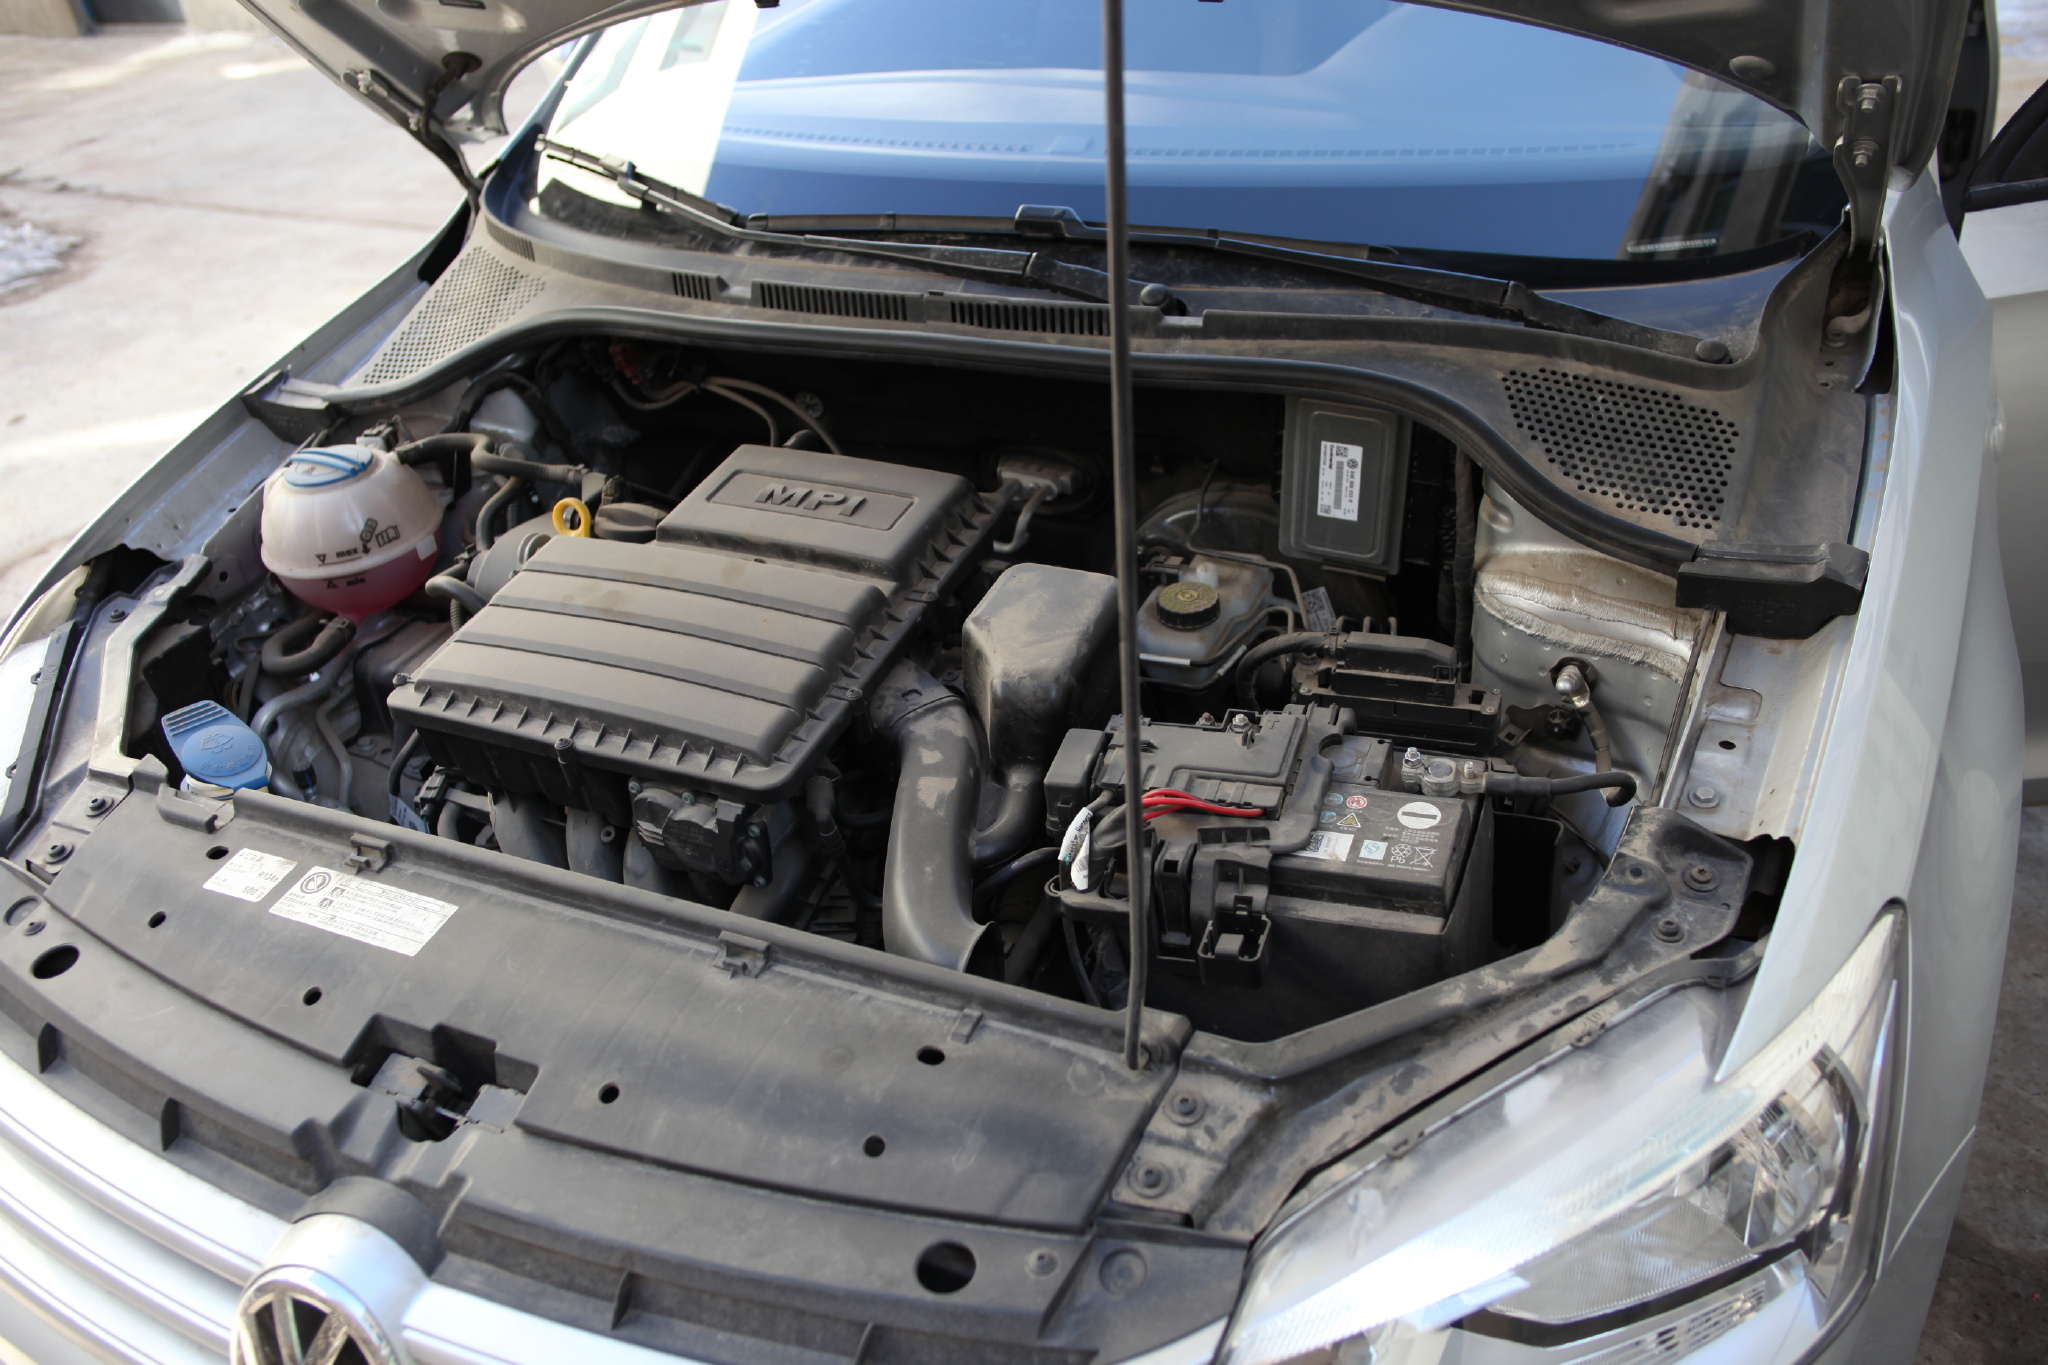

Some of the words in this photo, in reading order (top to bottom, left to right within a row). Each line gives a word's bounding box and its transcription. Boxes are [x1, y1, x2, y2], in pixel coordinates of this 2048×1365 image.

[754, 483, 867, 518] MPI
[336, 548, 358, 558] max
[346, 578, 365, 586] min
[1391, 855, 1406, 864] Pb
[241, 885, 259, 896] 500
